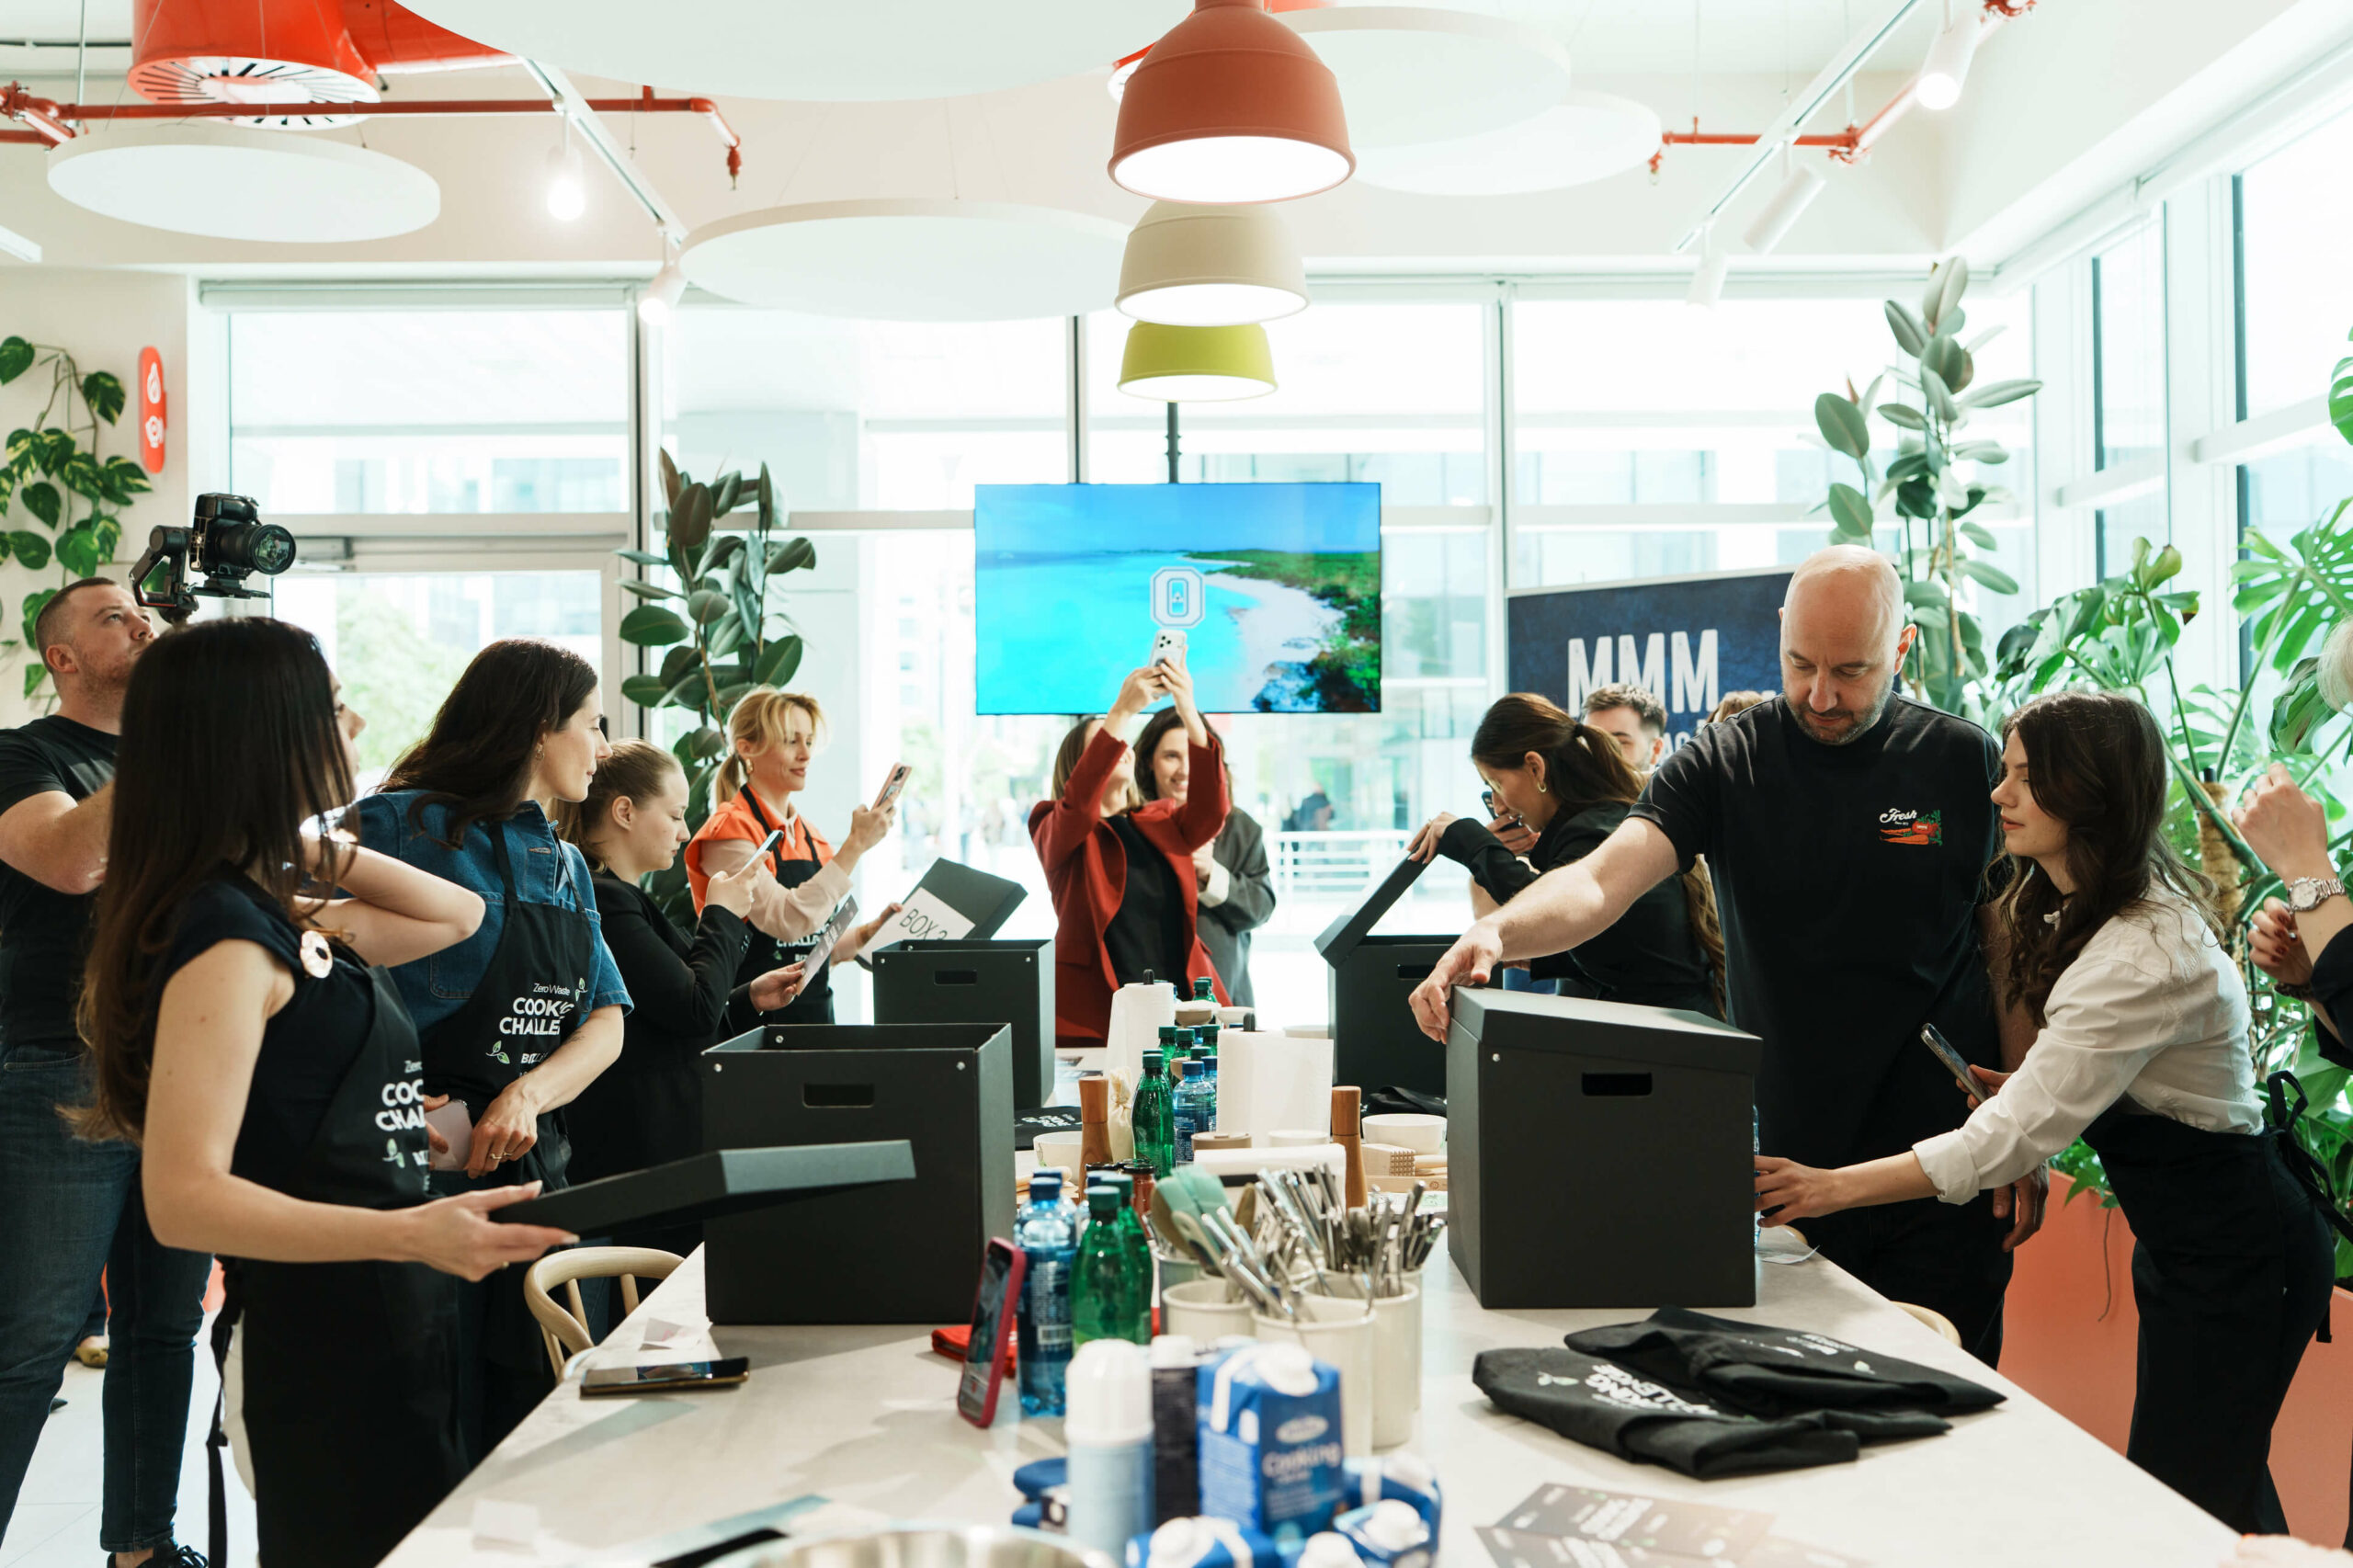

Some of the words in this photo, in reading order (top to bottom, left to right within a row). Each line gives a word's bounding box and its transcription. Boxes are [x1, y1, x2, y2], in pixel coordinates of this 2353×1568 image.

[1568, 629, 1719, 719] MMM
[1880, 808, 1917, 823] Fresh
[900, 908, 938, 940] BOX
[533, 983, 549, 994] Zero
[549, 984, 570, 996] Waste
[499, 1017, 561, 1035] CHALLE
